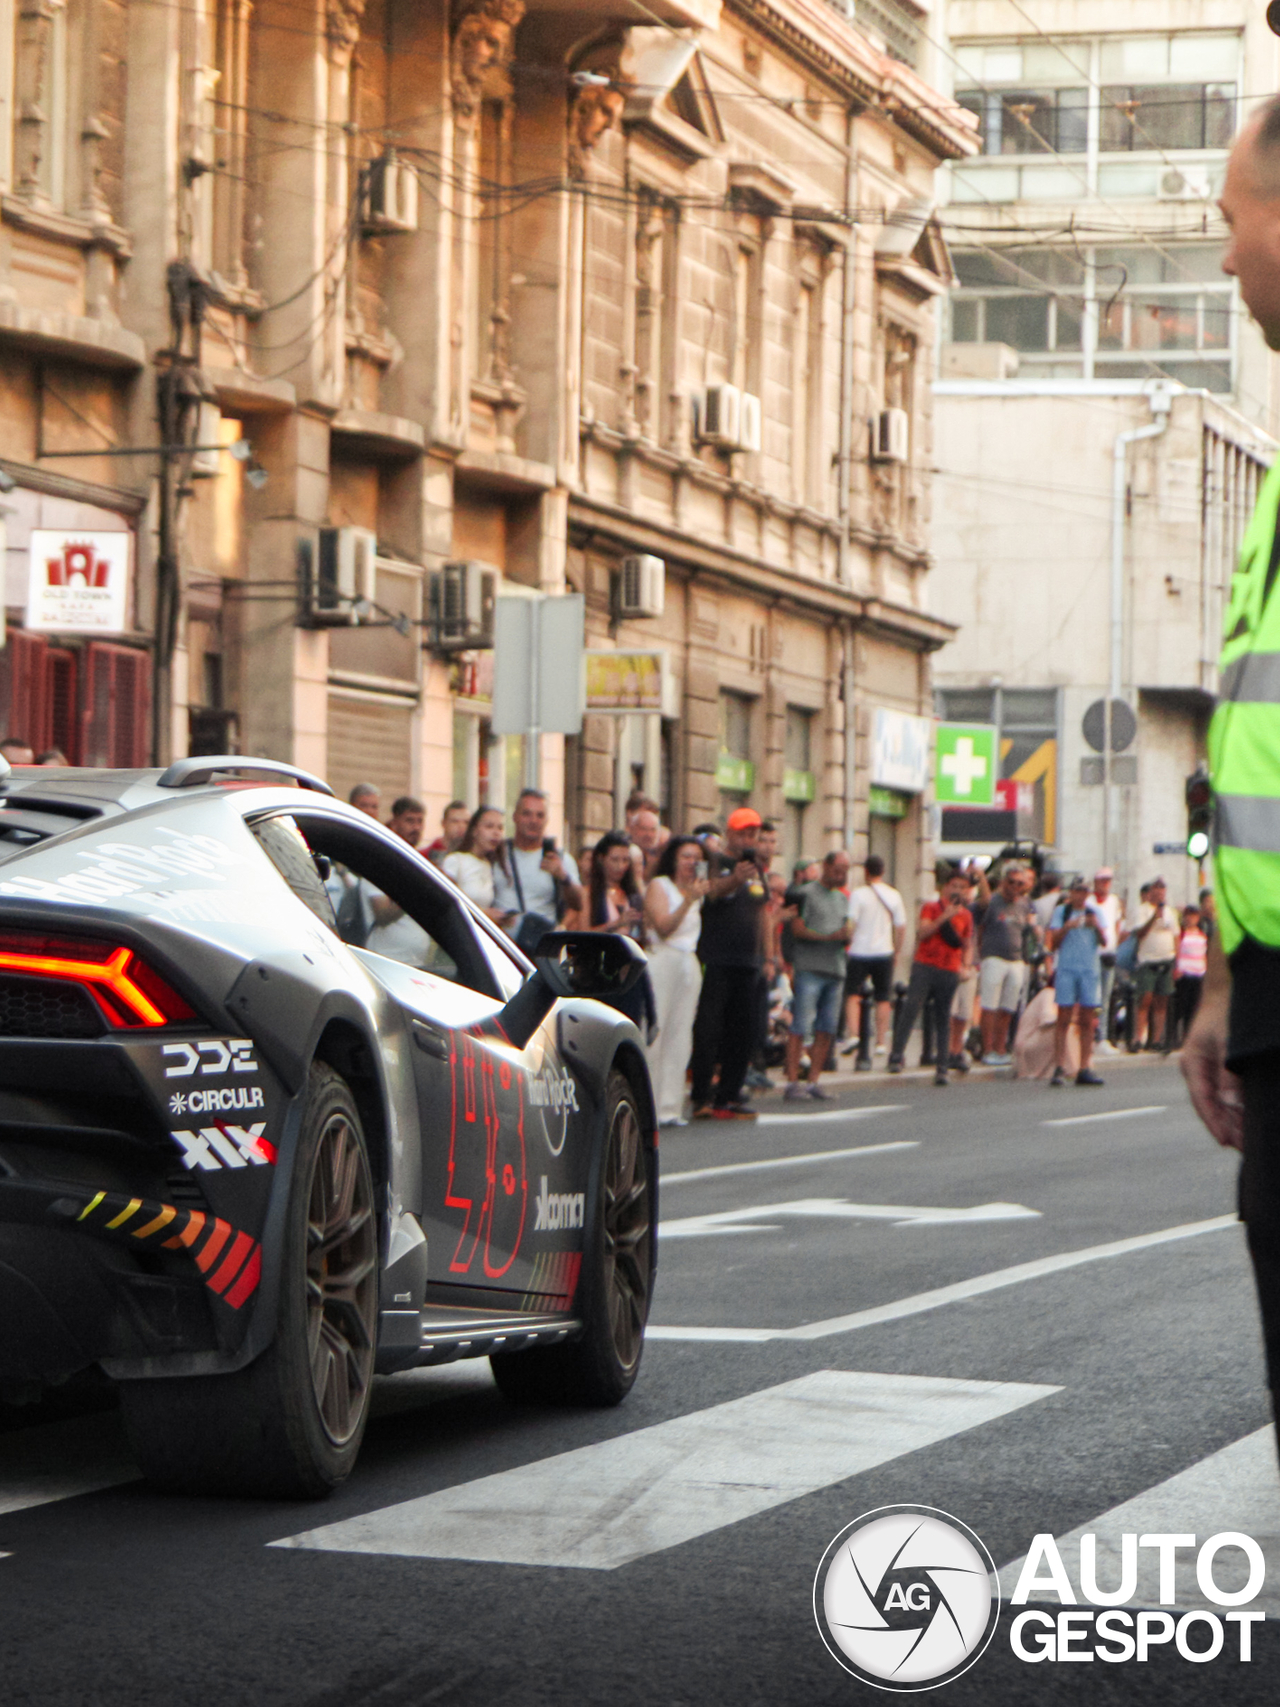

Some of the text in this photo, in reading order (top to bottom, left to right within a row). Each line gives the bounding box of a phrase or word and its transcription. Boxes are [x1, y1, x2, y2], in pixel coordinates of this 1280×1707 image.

[162, 1039, 259, 1078] DDE
[187, 1087, 265, 1112] CIRCULR
[171, 1122, 267, 1171] XIX
